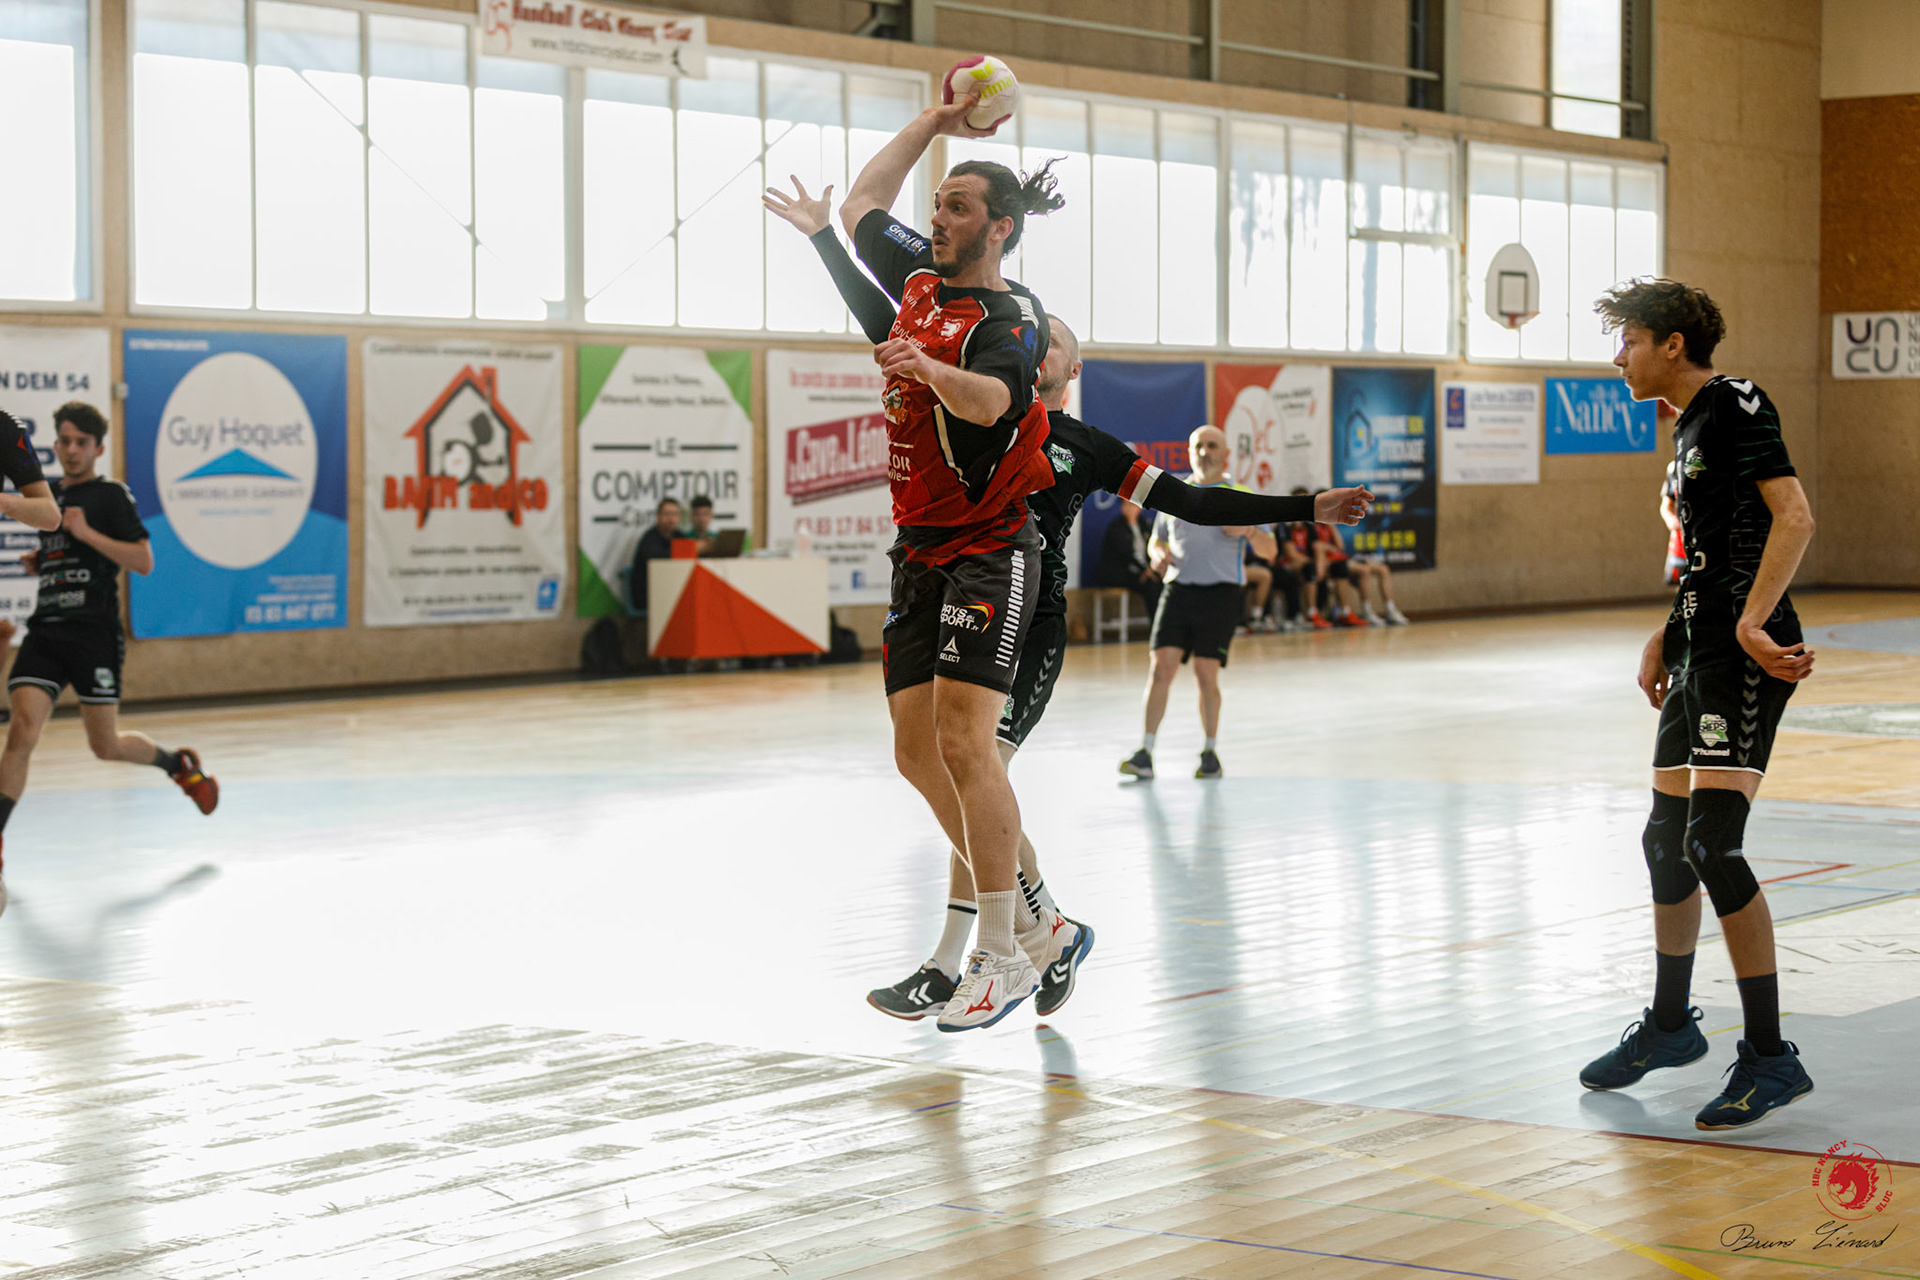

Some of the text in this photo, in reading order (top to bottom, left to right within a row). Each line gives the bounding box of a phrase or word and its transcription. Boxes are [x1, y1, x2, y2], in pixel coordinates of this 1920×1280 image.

[16, 372, 58, 390] DEM
[66, 374, 89, 391] 54
[167, 416, 304, 450] Guy Hoquet
[656, 438, 677, 458] LE
[889, 453, 911, 471] OIR
[592, 470, 738, 501] COMPTOIR
[939, 652, 961, 664] SELECT
